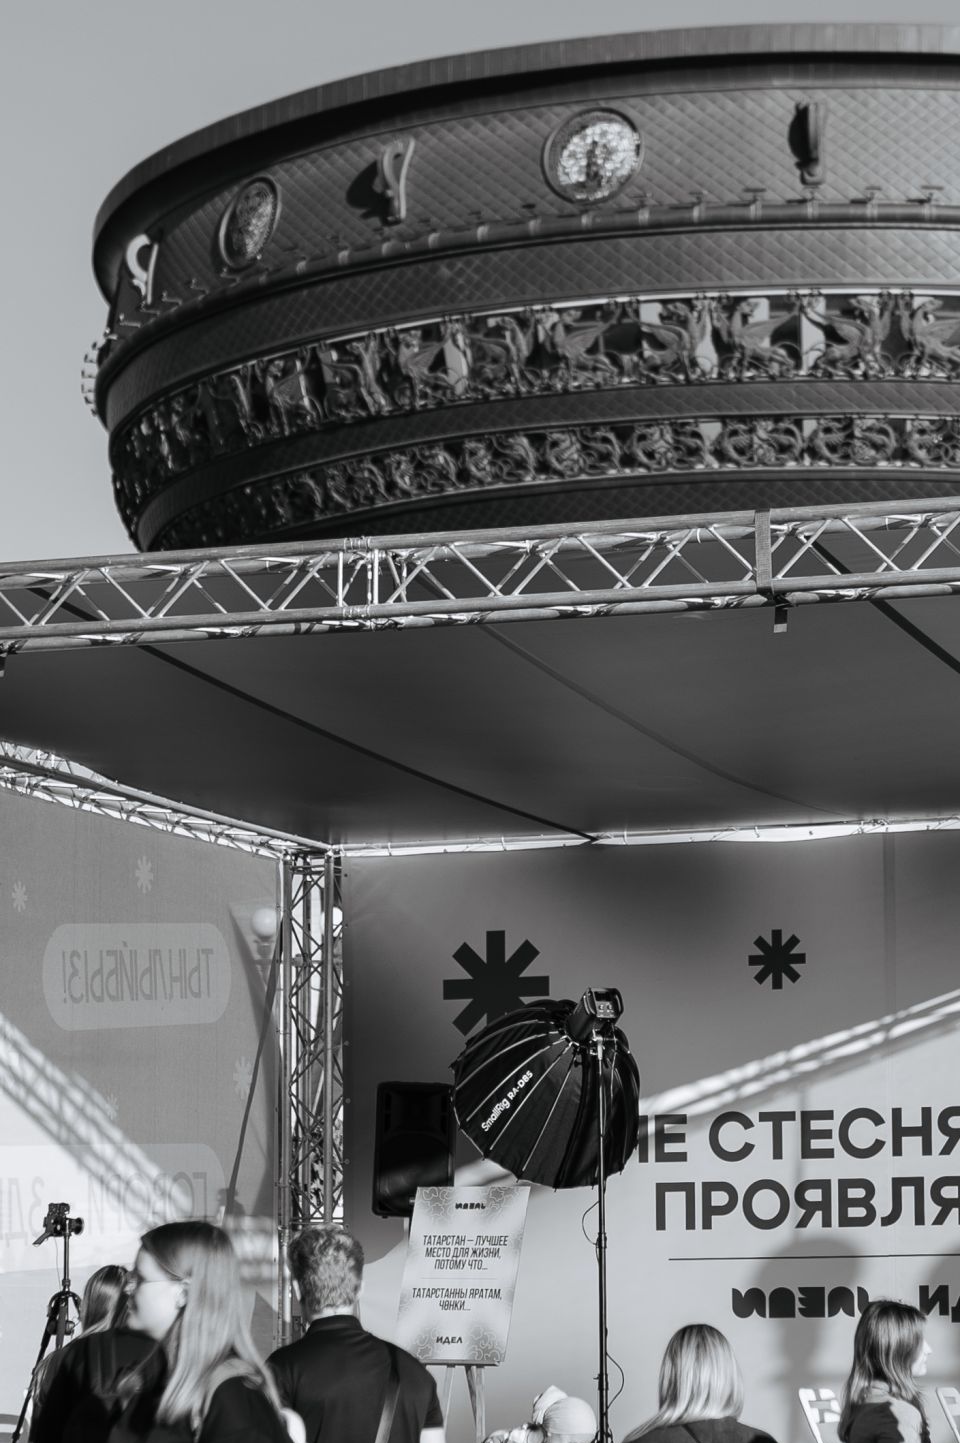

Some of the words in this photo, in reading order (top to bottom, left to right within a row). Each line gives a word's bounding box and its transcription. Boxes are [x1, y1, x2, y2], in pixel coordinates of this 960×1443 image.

[481, 1098, 511, 1132] SmallRig
[423, 1235, 467, 1246] ТАТАРСТАН
[474, 1235, 509, 1247] ЛУЧШЕЕ
[425, 1247, 451, 1258] МЕСТО
[451, 1247, 469, 1259] ДЛЯ
[470, 1247, 501, 1260] ЖИЗНИ,
[434, 1259, 466, 1270] ПОТОМУ
[412, 1288, 467, 1299] ТАТАРСТАННЫ
[468, 1288, 502, 1300] ЯРАТАМ,
[436, 1336, 463, 1344] ИДЕЛ
